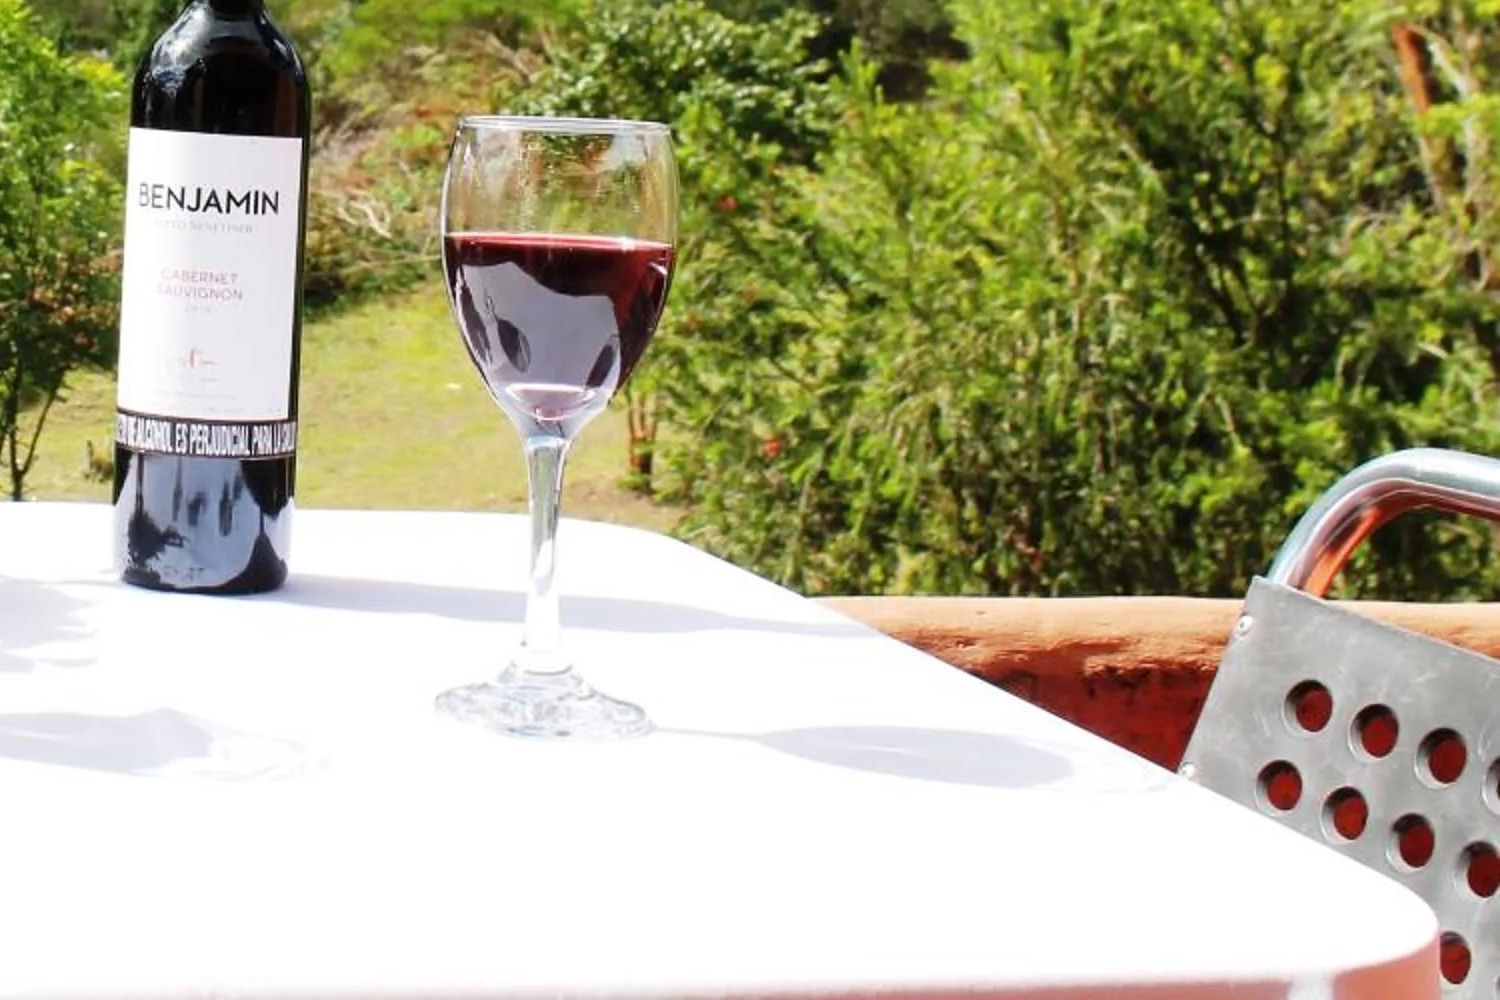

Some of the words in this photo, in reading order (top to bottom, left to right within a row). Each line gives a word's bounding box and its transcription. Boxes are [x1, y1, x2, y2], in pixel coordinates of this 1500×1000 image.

[139, 182, 279, 216] BENJAMIN
[160, 268, 239, 286] CABERNET
[156, 284, 243, 301] SAUVIGNON
[175, 422, 188, 455] ES
